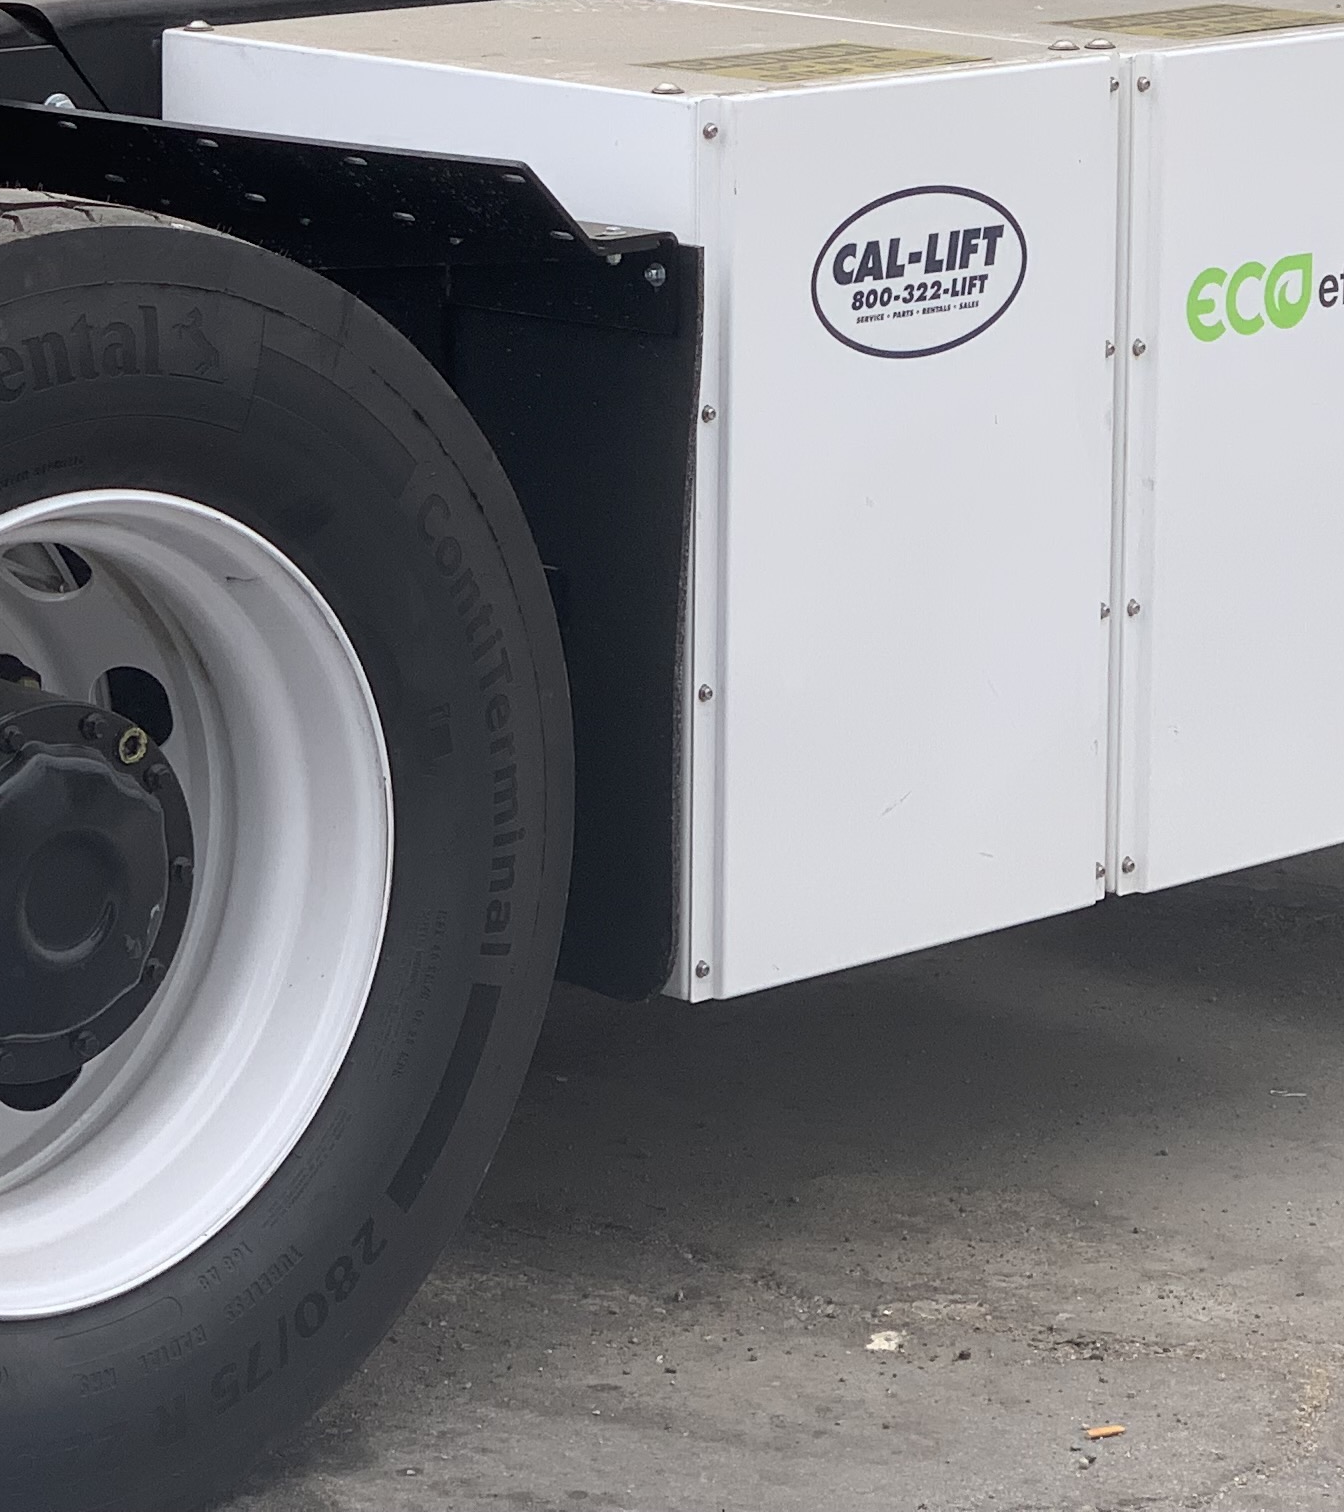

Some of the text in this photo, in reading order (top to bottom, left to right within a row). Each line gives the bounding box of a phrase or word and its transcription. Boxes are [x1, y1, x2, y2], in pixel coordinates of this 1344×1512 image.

[832, 224, 1005, 286] CAL-LIFT
[851, 273, 989, 311] 800-322-LIFT
[856, 300, 979, 324] SERVICE PARTS RENTALS SALES
[416, 492, 526, 958] ContiTerminal
[210, 1217, 390, 1415] 280/75
